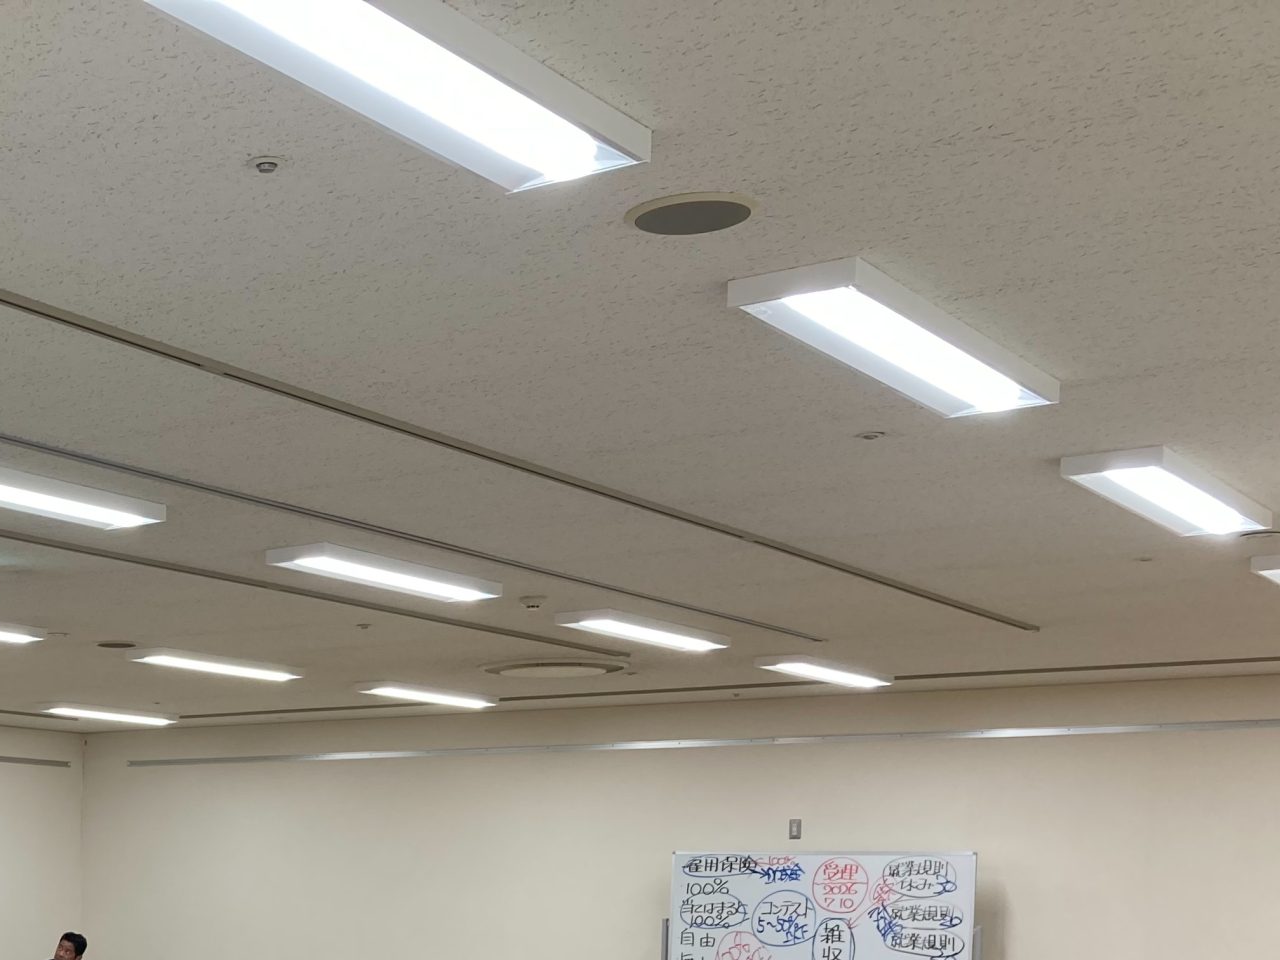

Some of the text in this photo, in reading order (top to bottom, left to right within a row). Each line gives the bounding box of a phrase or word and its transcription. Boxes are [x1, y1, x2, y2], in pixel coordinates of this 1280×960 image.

[687, 855, 757, 873] 雇用保険
[686, 878, 729, 896] 100%
[761, 896, 814, 918] コンテスト
[680, 928, 716, 947] 自由
